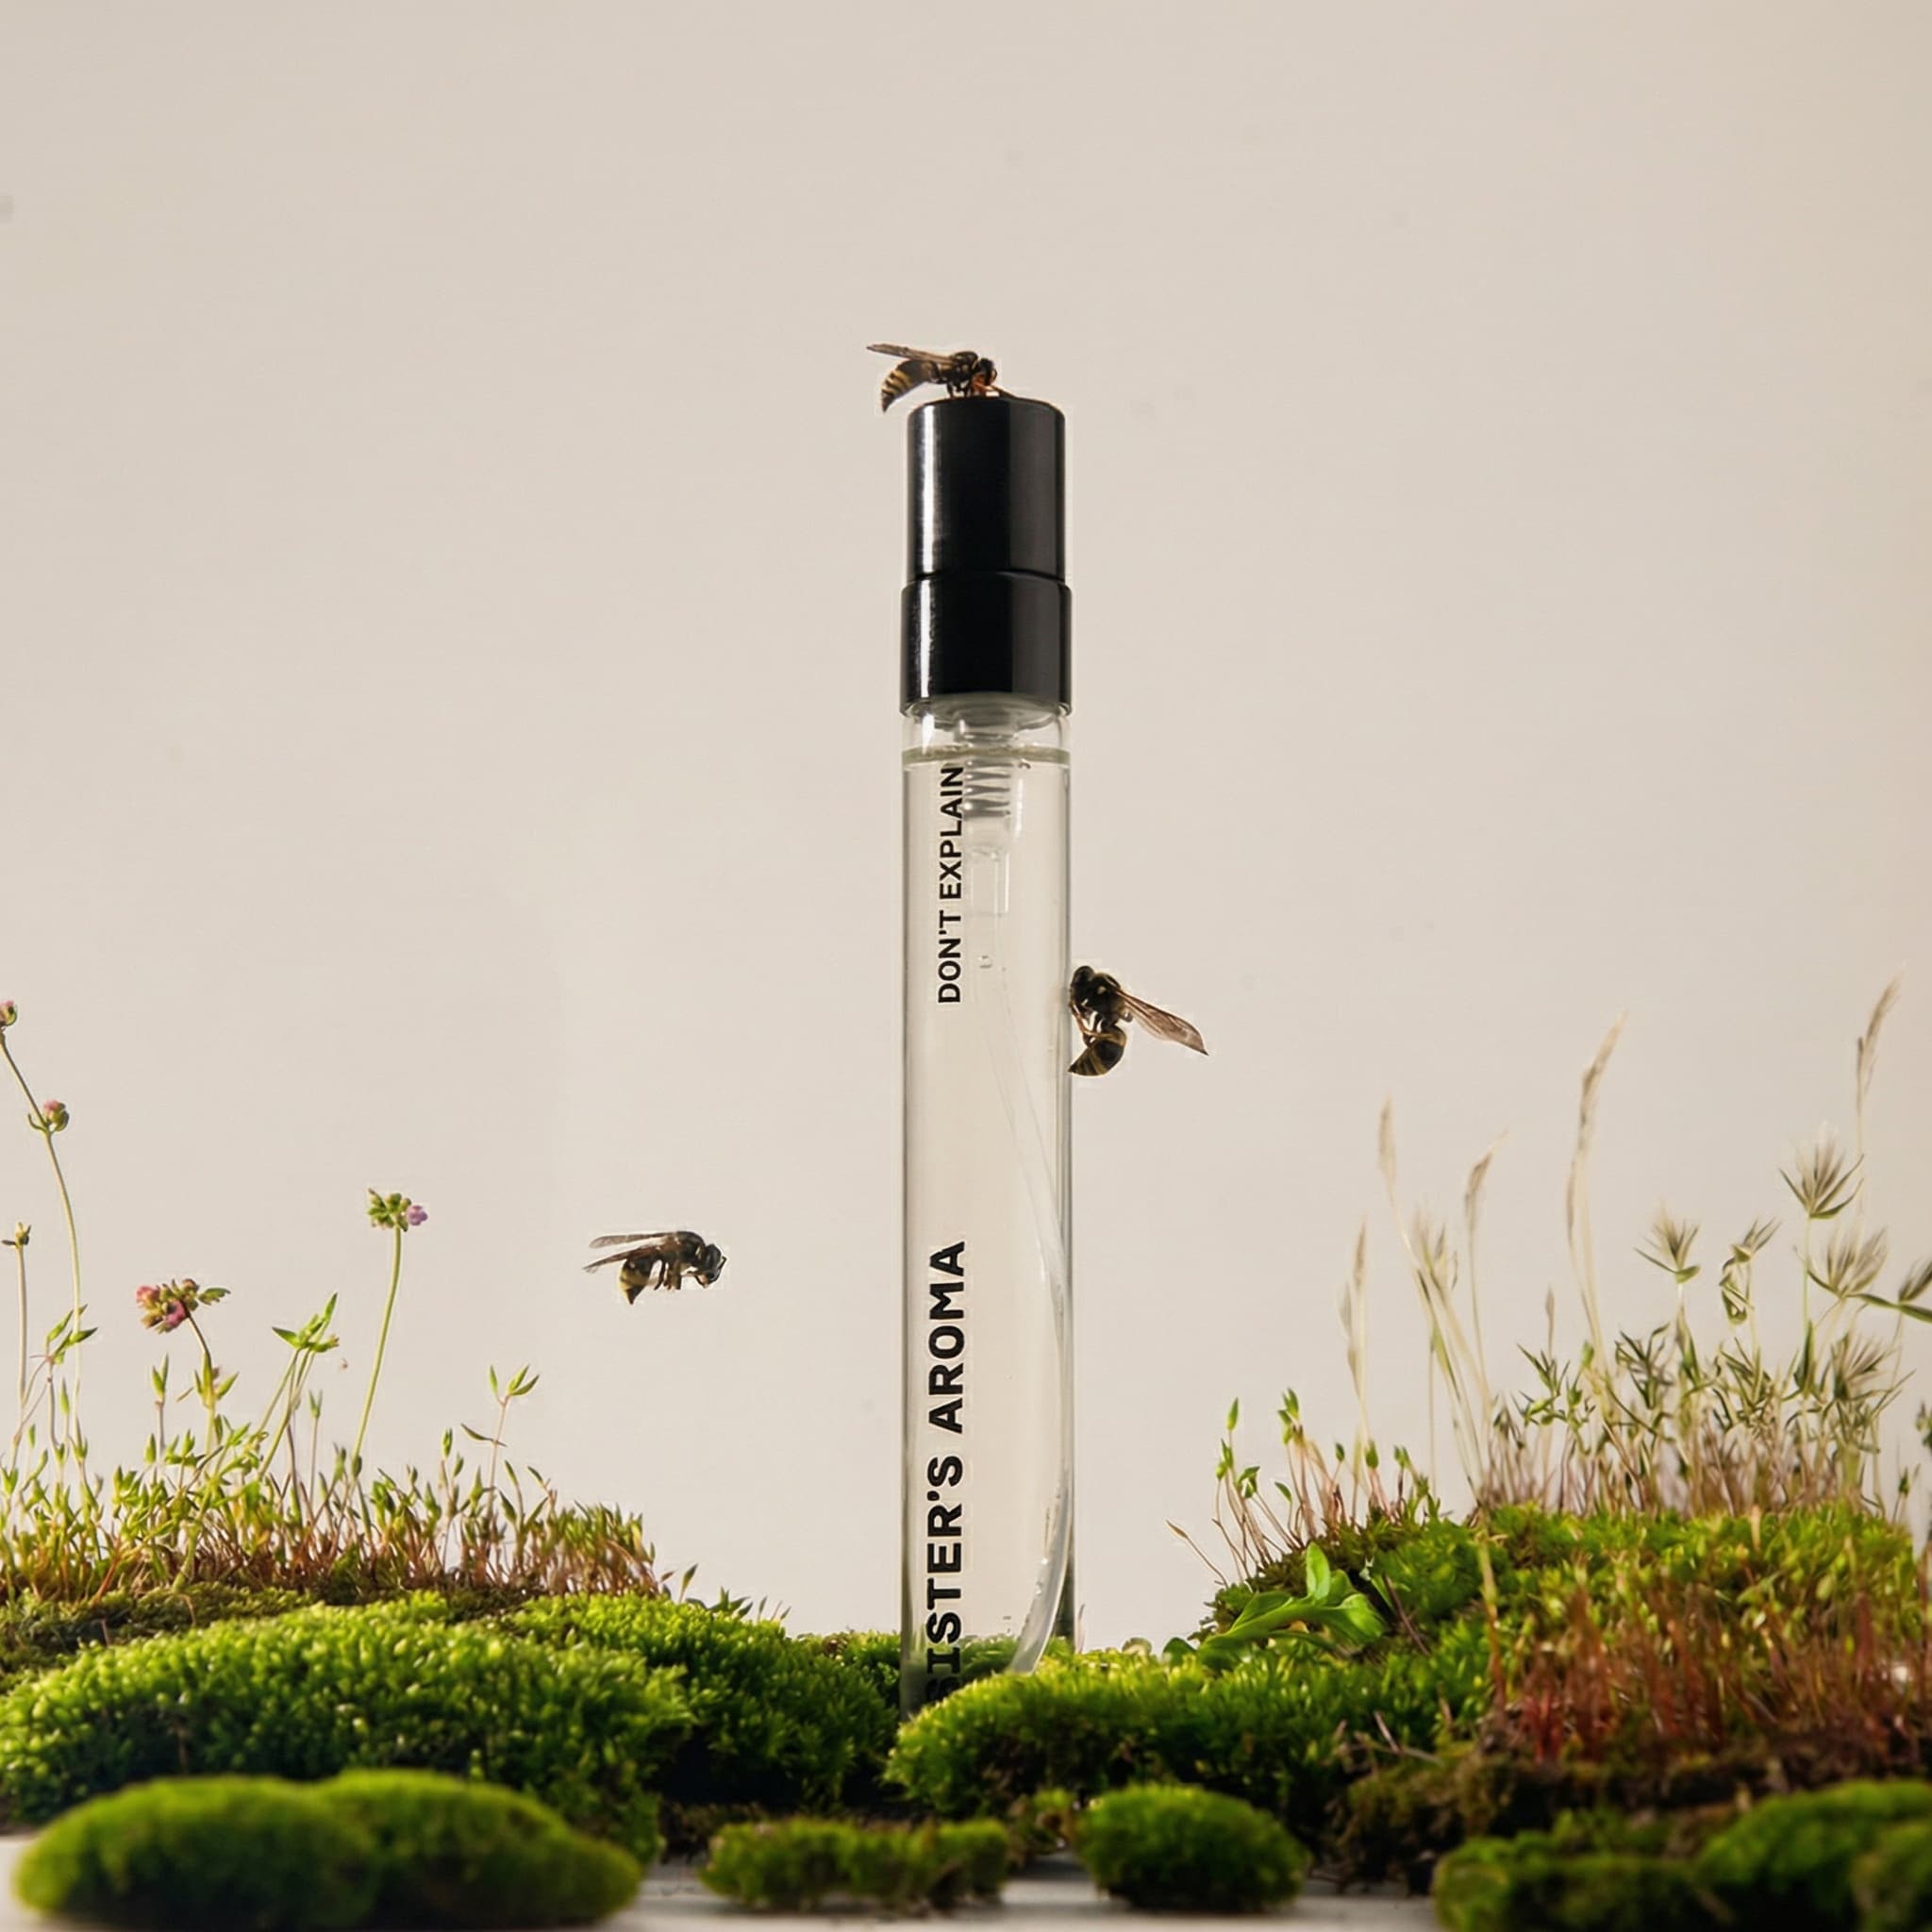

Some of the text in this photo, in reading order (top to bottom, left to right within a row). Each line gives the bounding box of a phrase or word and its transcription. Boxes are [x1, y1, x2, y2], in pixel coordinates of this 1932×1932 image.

[938, 766, 964, 1004] DON'T EXPLAIN
[928, 1241, 965, 1434] AROMA
